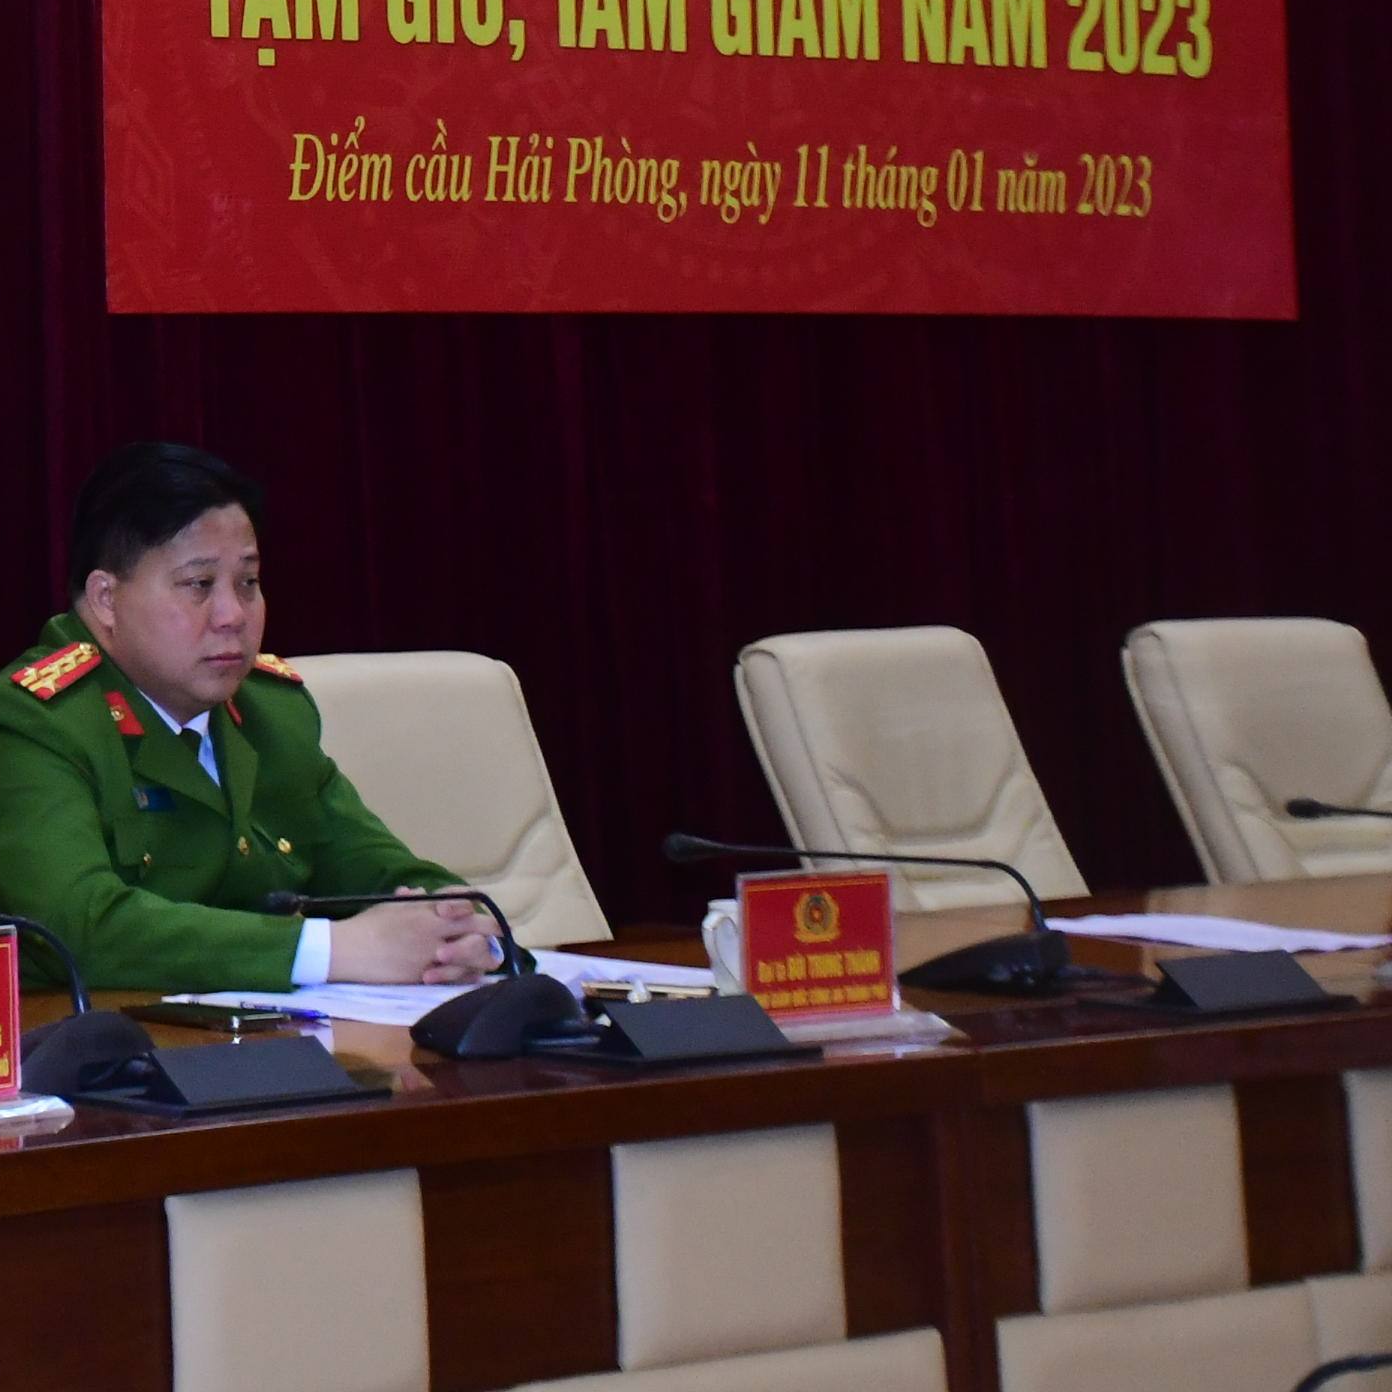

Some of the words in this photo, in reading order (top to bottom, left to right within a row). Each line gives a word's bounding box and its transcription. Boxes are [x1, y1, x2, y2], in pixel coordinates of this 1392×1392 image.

[289, 115, 393, 202] Điểm
[406, 119, 472, 202] cầu
[484, 133, 554, 203] Hải
[565, 136, 688, 224] Phòng,
[700, 141, 781, 225] ngày
[794, 144, 829, 208] 11
[842, 144, 939, 228] tháng
[947, 149, 984, 211] 01
[997, 152, 1067, 214] năm
[1077, 153, 1153, 217] 2023
